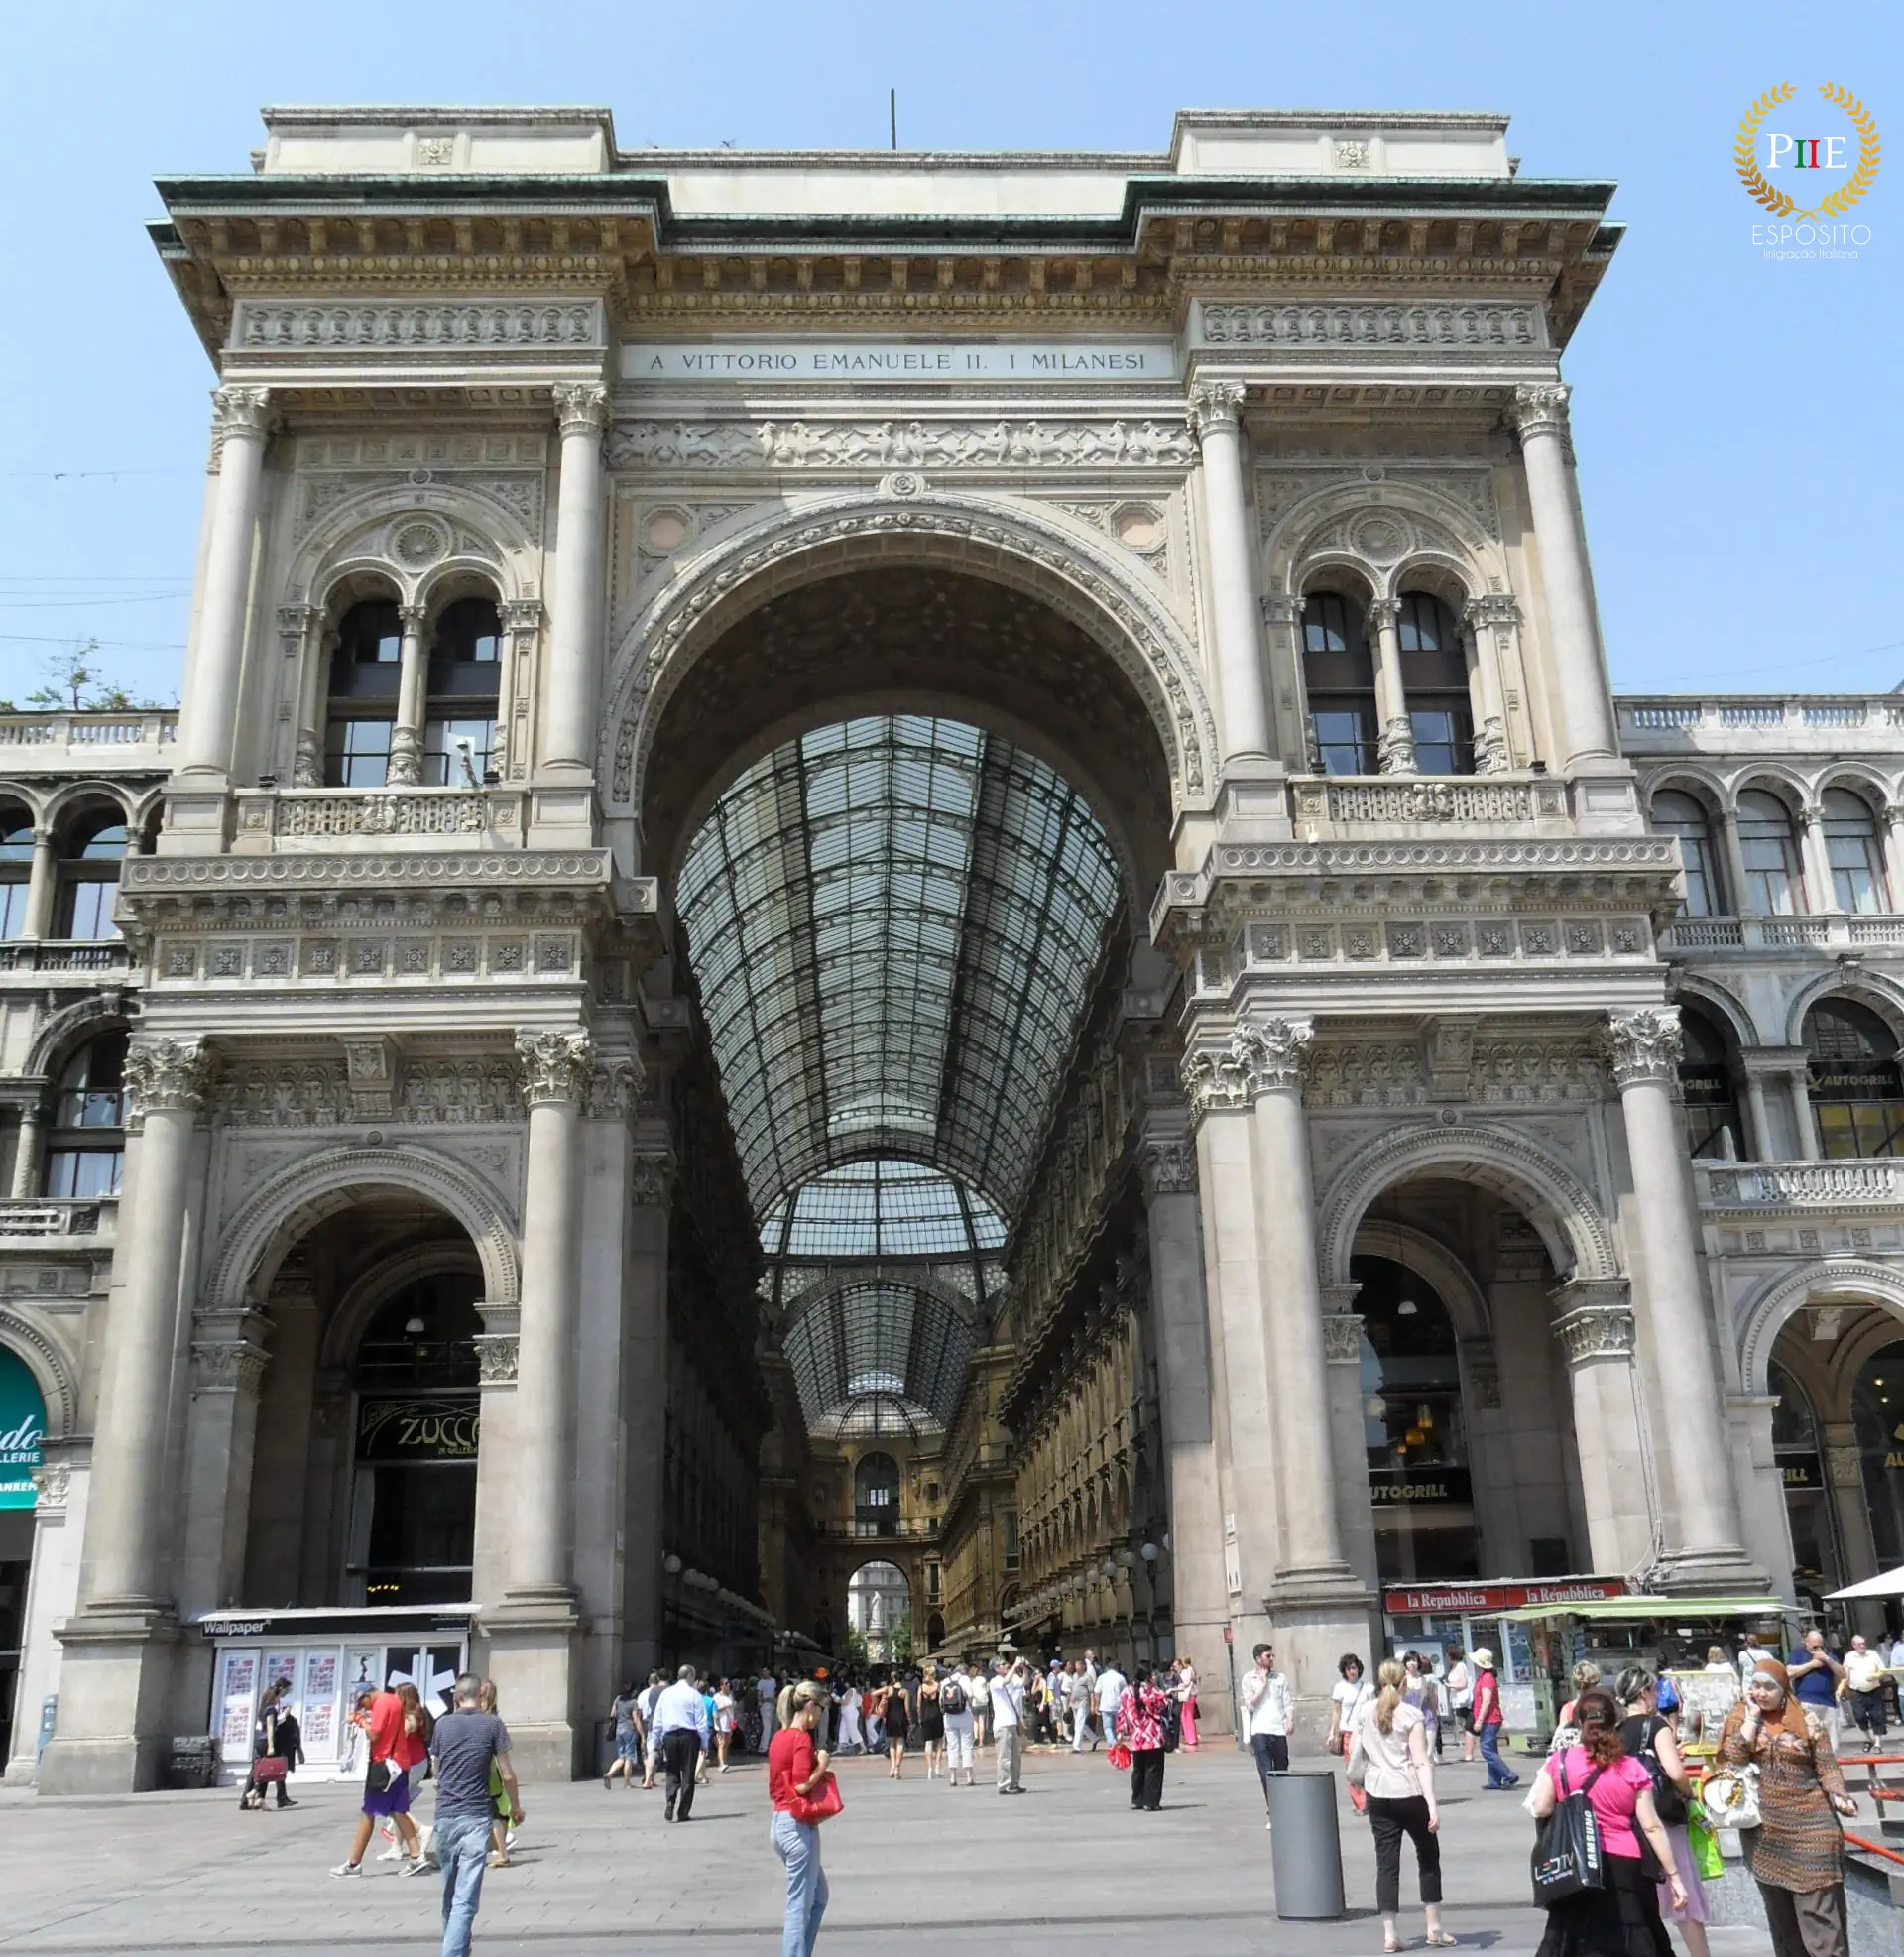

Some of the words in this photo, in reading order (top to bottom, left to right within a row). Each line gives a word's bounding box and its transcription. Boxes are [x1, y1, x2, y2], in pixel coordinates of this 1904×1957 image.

[650, 354, 664, 370] A
[682, 354, 797, 370] VITTORIO
[812, 354, 952, 370] EMANUELE
[1010, 354, 1015, 369] I
[1031, 354, 1145, 370] MILANESI
[1823, 1074, 1895, 1087] AUTOGRILL
[1407, 1594, 1420, 1608] la
[1421, 1593, 1486, 1610] Repubblica
[1527, 1588, 1538, 1603] la
[1539, 1585, 1605, 1603] Repubblica
[1584, 1810, 1598, 1870] SAMSUNG
